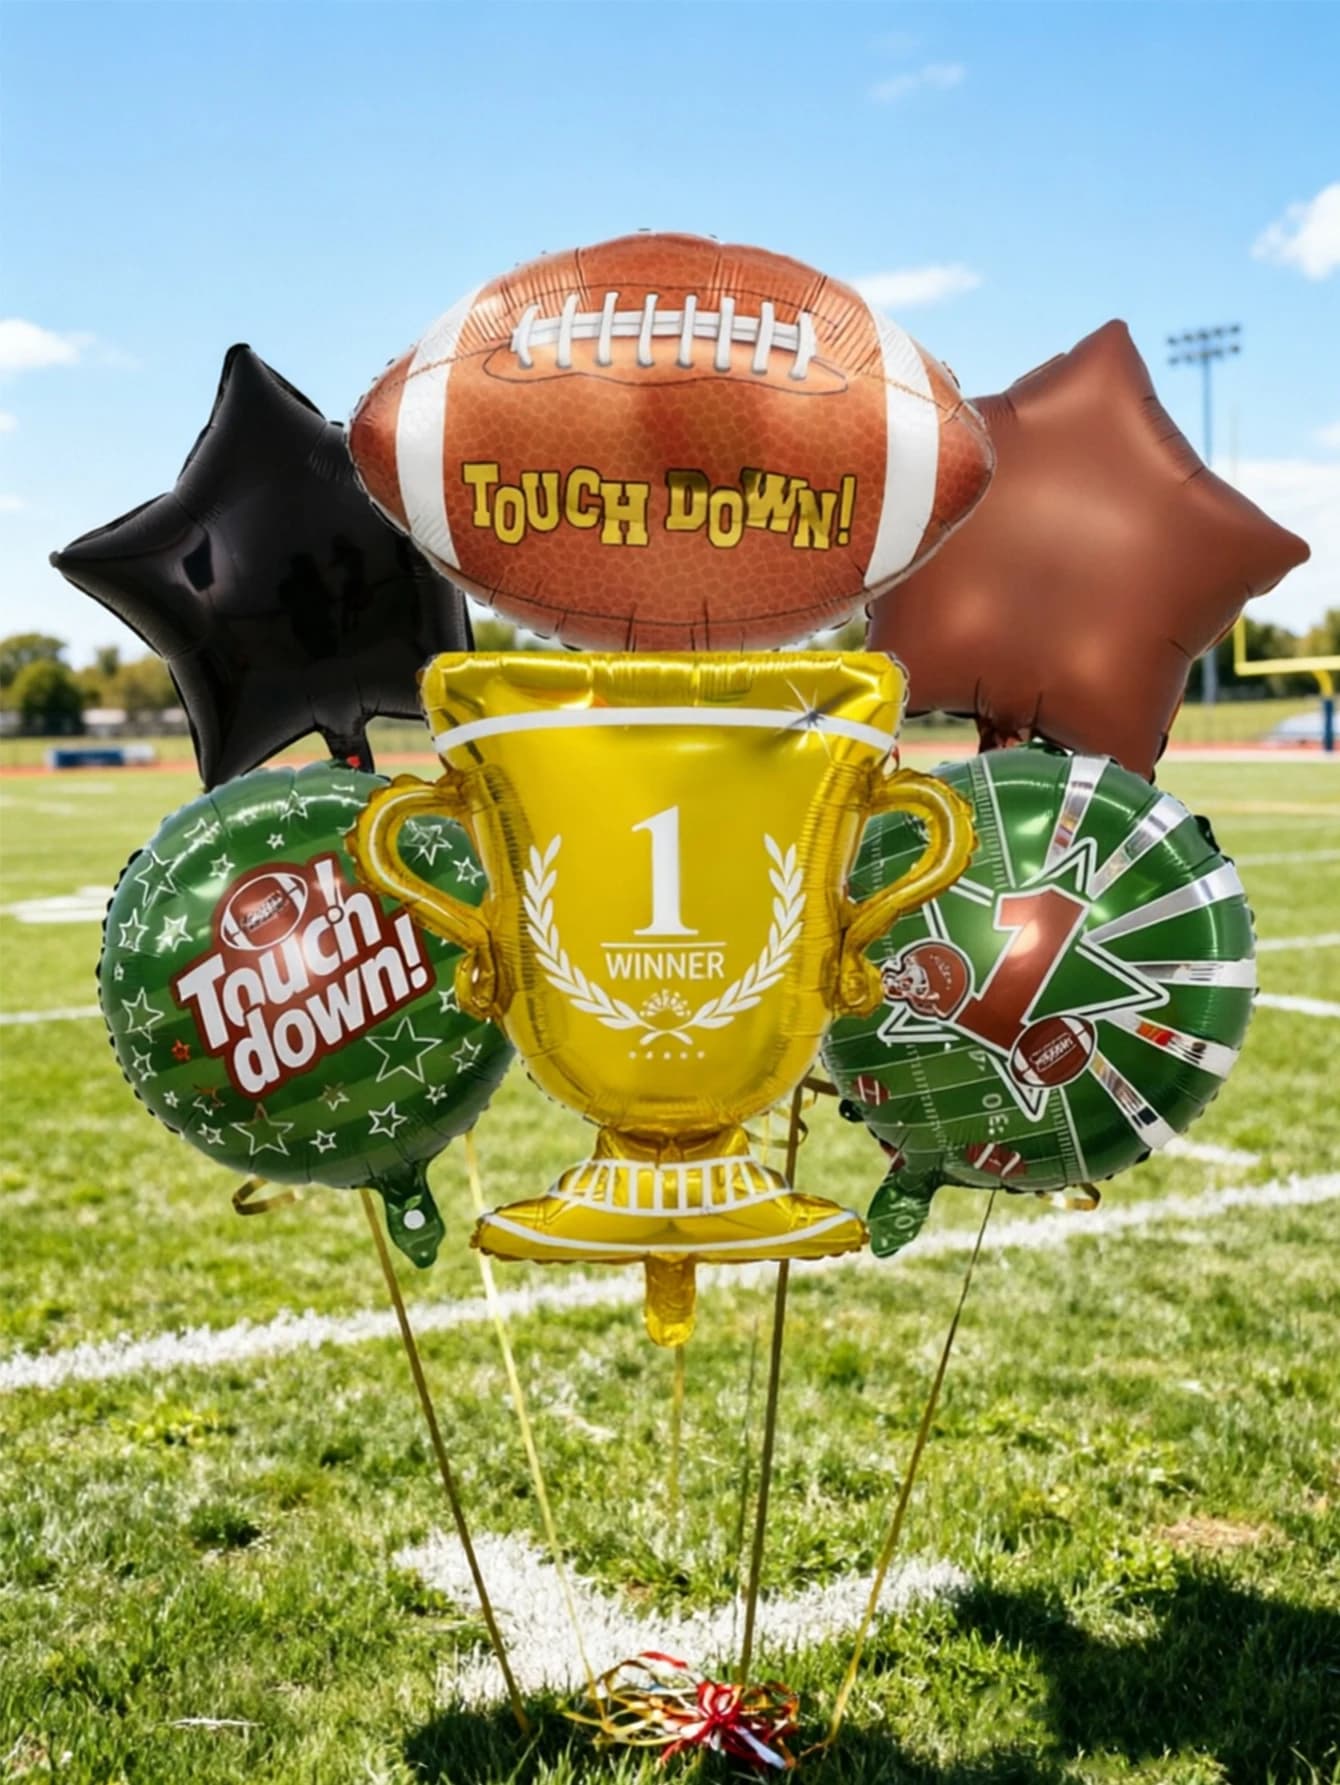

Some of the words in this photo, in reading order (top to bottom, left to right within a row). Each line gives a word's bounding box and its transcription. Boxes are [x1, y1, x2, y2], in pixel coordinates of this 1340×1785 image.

[462, 462, 650, 546] TOUCH
[664, 466, 857, 549] DOWN!
[631, 805, 699, 936] 1
[176, 859, 382, 1049] Touch
[233, 914, 428, 1093] down!
[604, 951, 725, 980] WINNER
